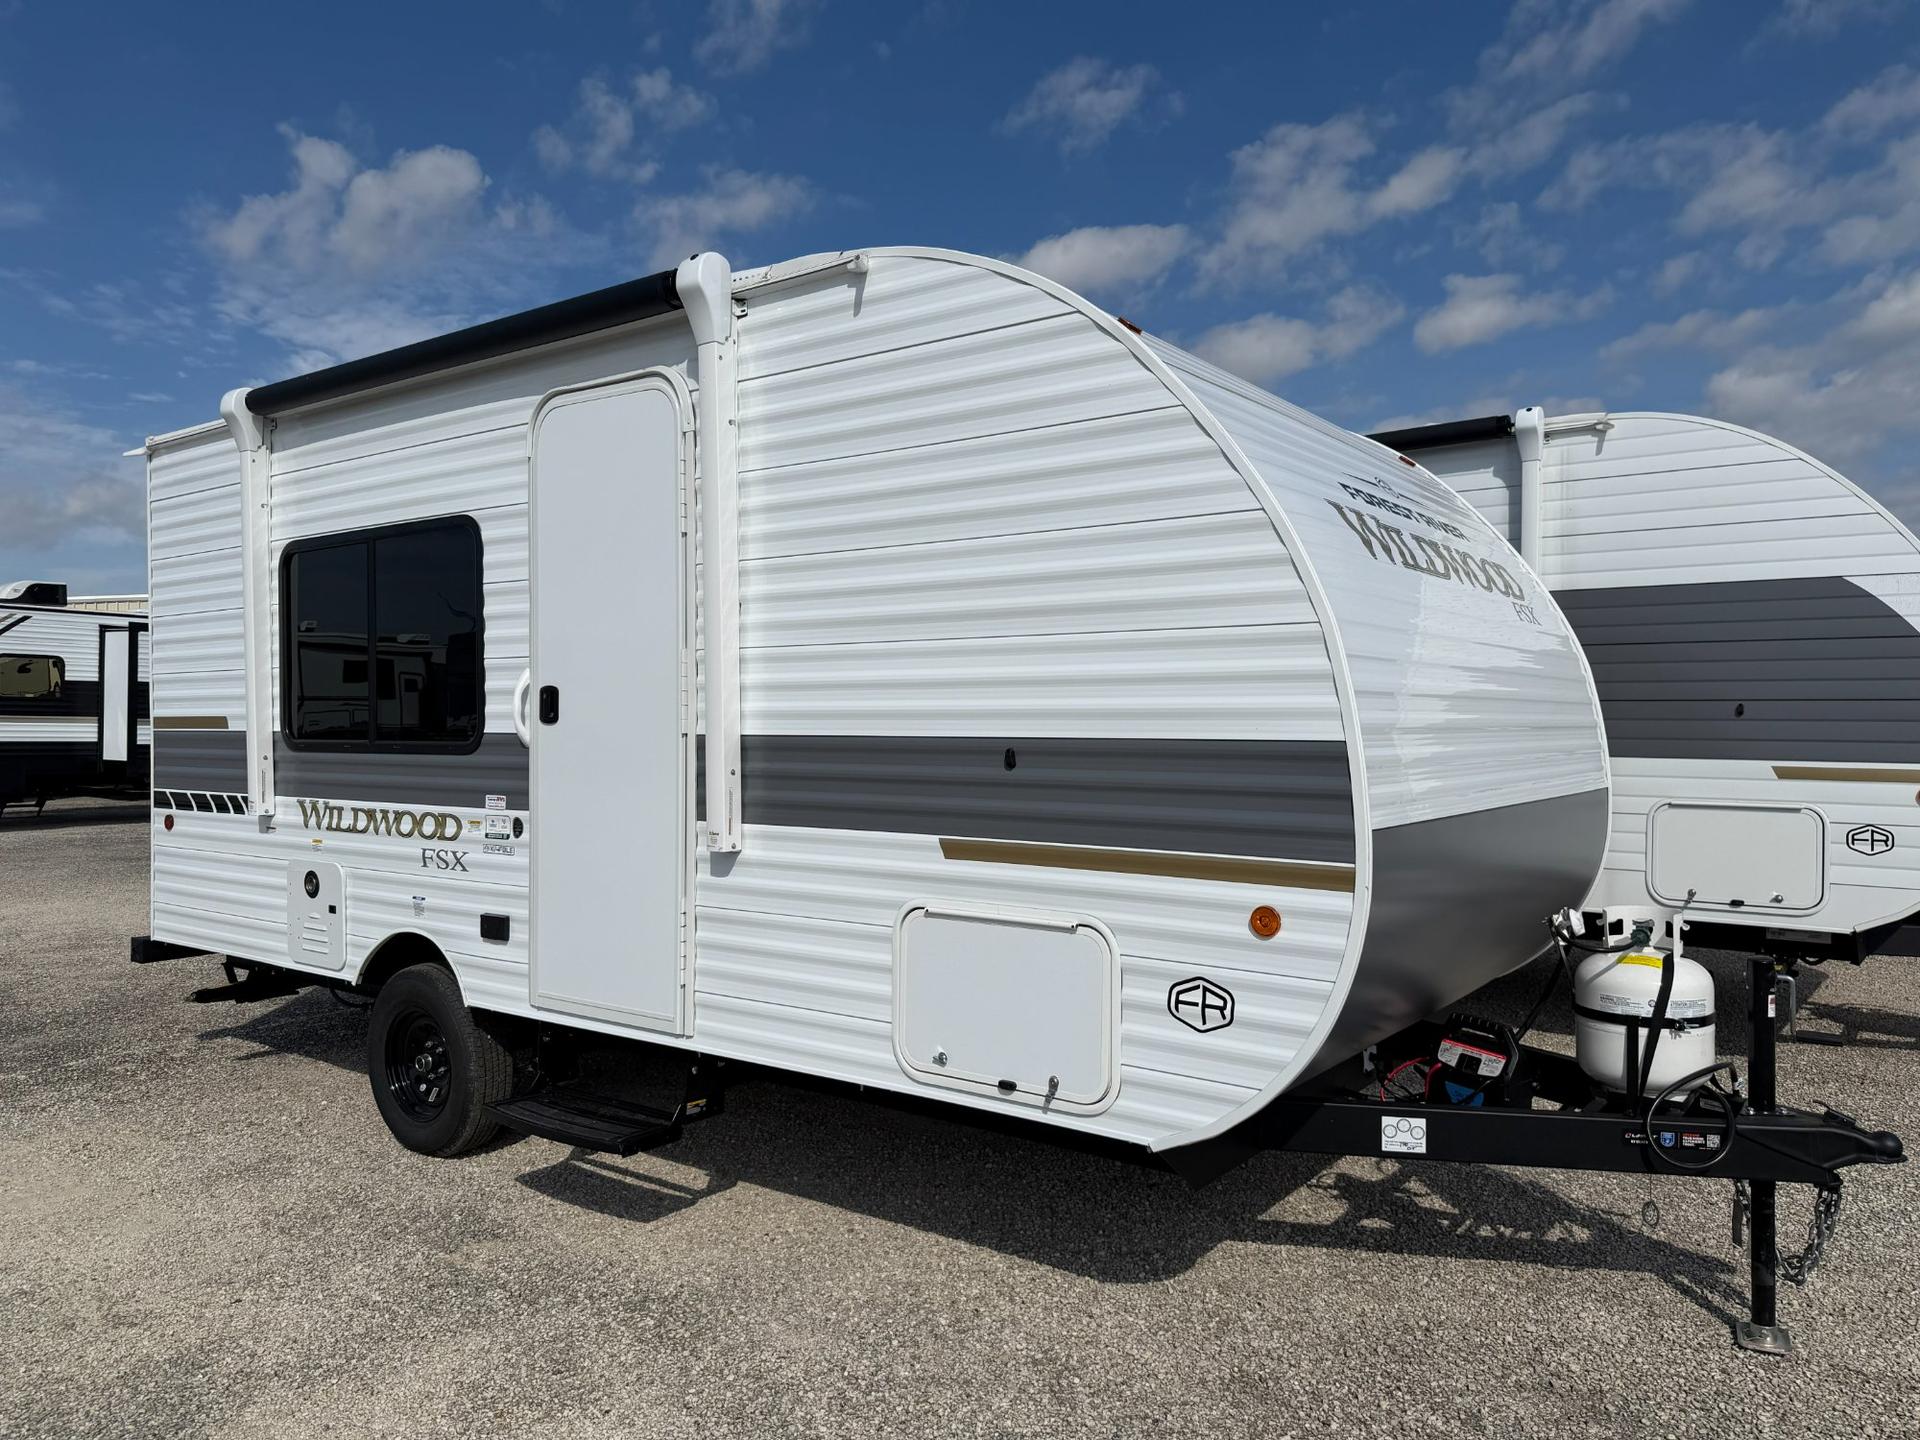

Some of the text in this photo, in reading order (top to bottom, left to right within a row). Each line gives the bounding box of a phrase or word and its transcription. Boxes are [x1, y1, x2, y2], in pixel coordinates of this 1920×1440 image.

[1337, 481, 1471, 543] FOREST RIVER
[1323, 497, 1526, 602] WILDWOOD
[1512, 601, 1543, 627] FSX
[296, 798, 463, 842] WILDWOOD
[1851, 828, 1890, 852] FR
[421, 847, 470, 873] FSX
[1174, 983, 1228, 1026] FR
